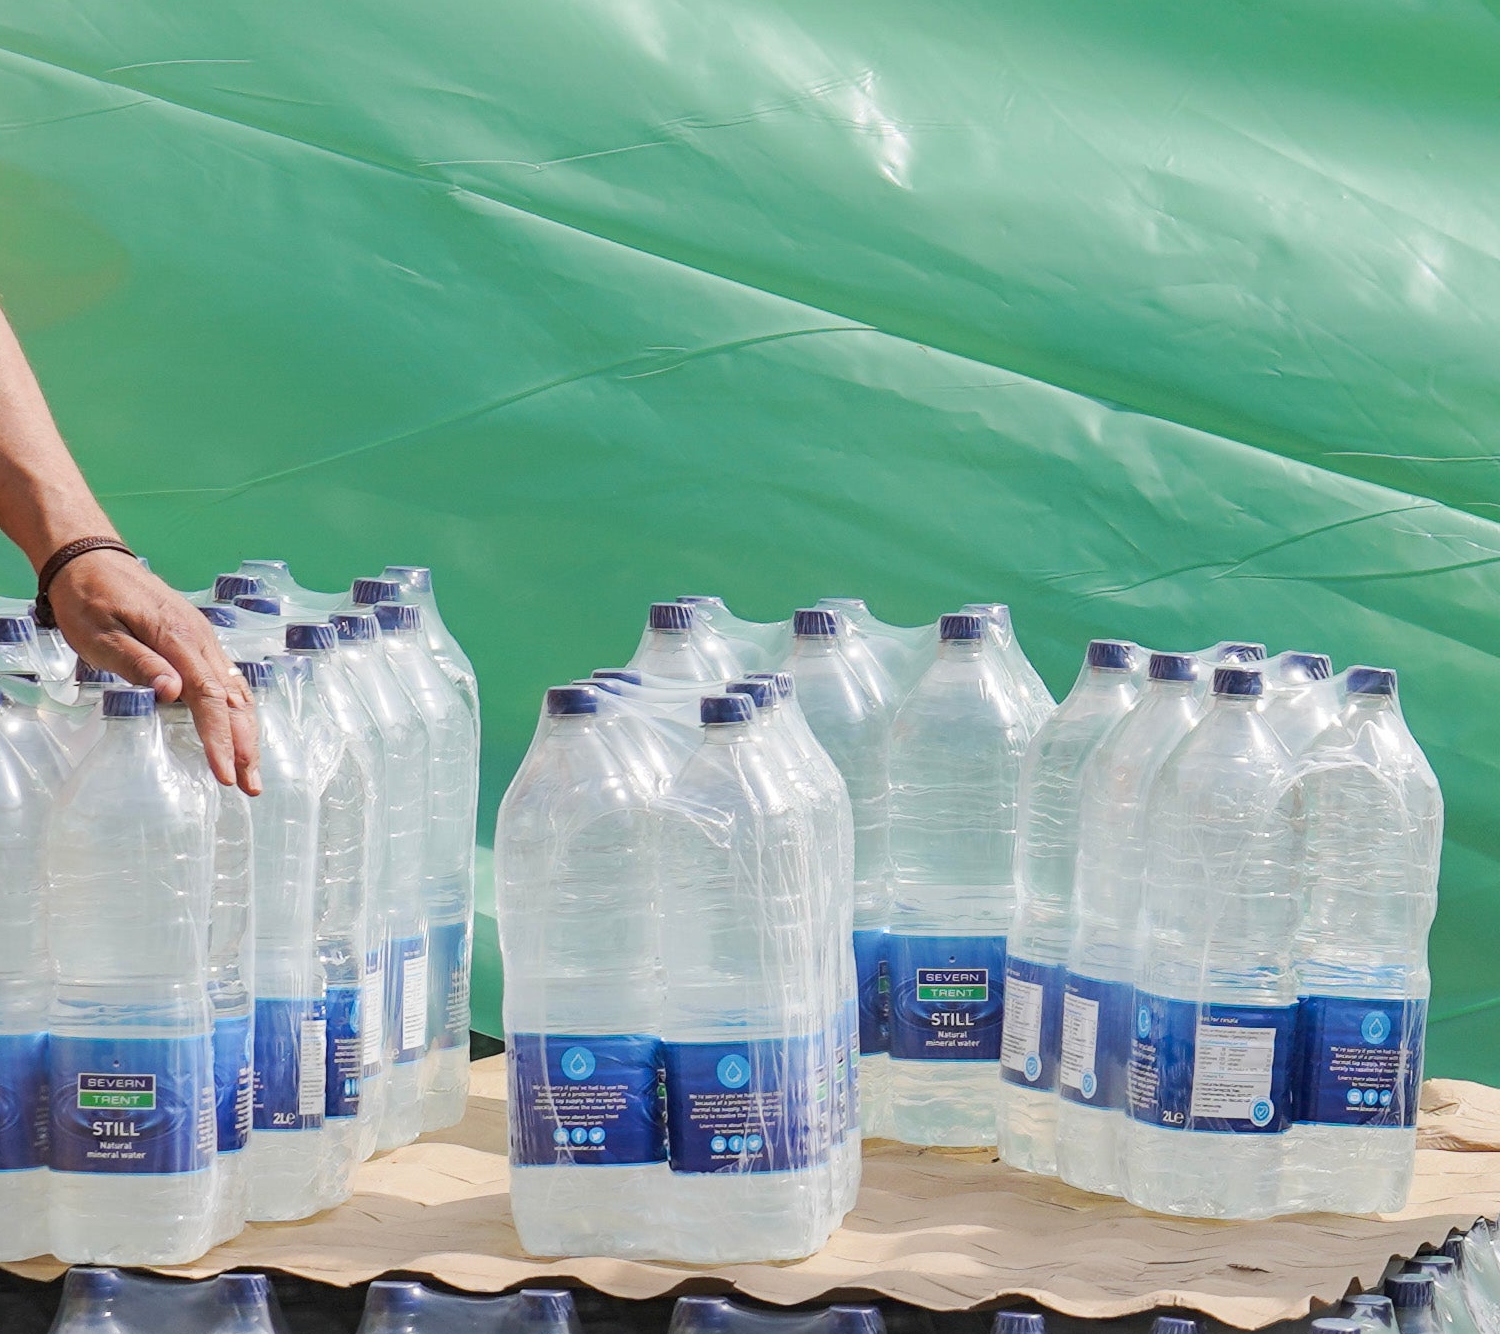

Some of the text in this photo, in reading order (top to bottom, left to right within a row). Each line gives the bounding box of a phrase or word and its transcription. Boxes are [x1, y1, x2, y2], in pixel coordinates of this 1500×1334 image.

[925, 973, 979, 982] SEVERN
[930, 988, 974, 997] TRENT
[931, 1012, 975, 1026] STILL
[937, 1030, 968, 1039] Natural
[925, 1039, 980, 1048] mineral water
[87, 1078, 146, 1088] SEVERN
[92, 1095, 140, 1104] TRENT
[92, 1121, 140, 1137] STILL
[99, 1141, 132, 1150] Natural
[86, 1150, 146, 1159] mineral water
